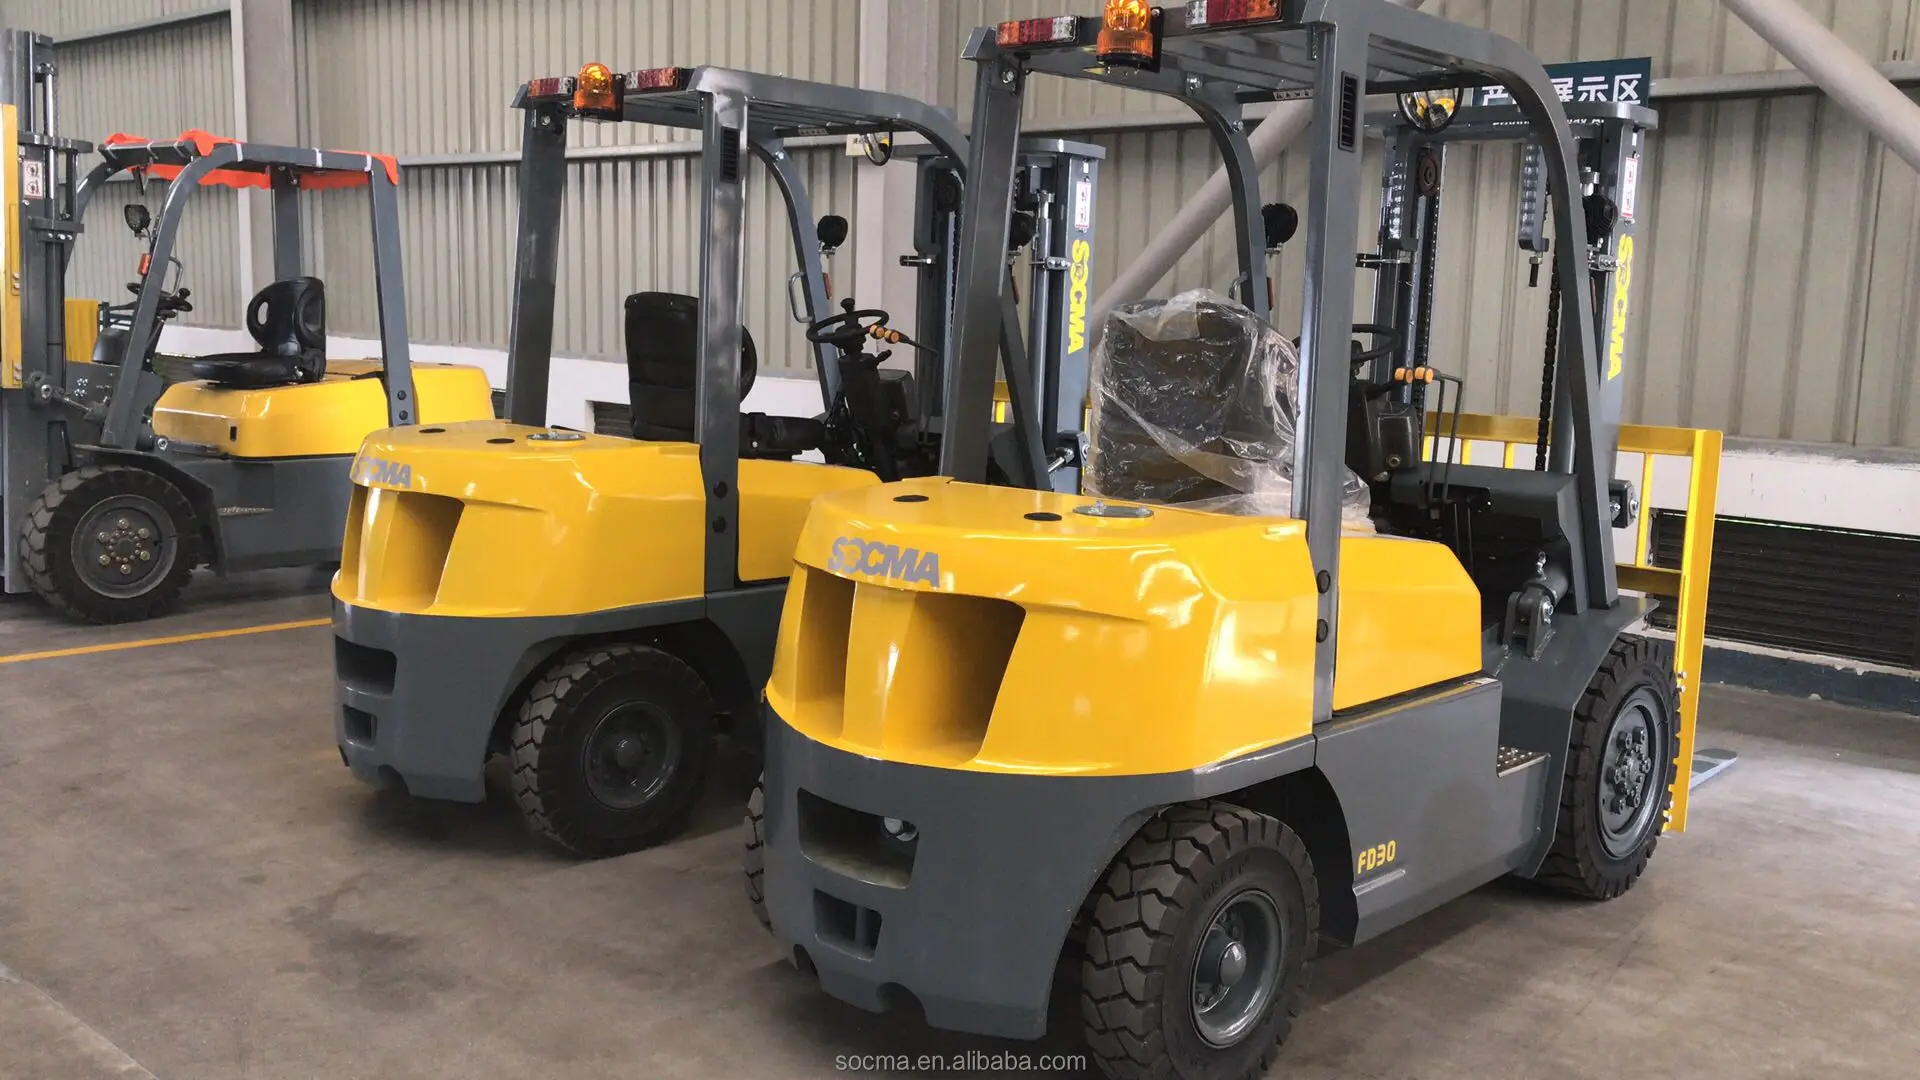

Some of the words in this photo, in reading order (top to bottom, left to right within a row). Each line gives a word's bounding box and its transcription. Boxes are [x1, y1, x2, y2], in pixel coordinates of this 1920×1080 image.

[1481, 73, 1643, 106] 产展示区
[1067, 239, 1091, 355] SOCMA
[1607, 233, 1634, 381] SOCMA
[828, 536, 940, 588] SOCMA
[1357, 839, 1397, 875] FD30
